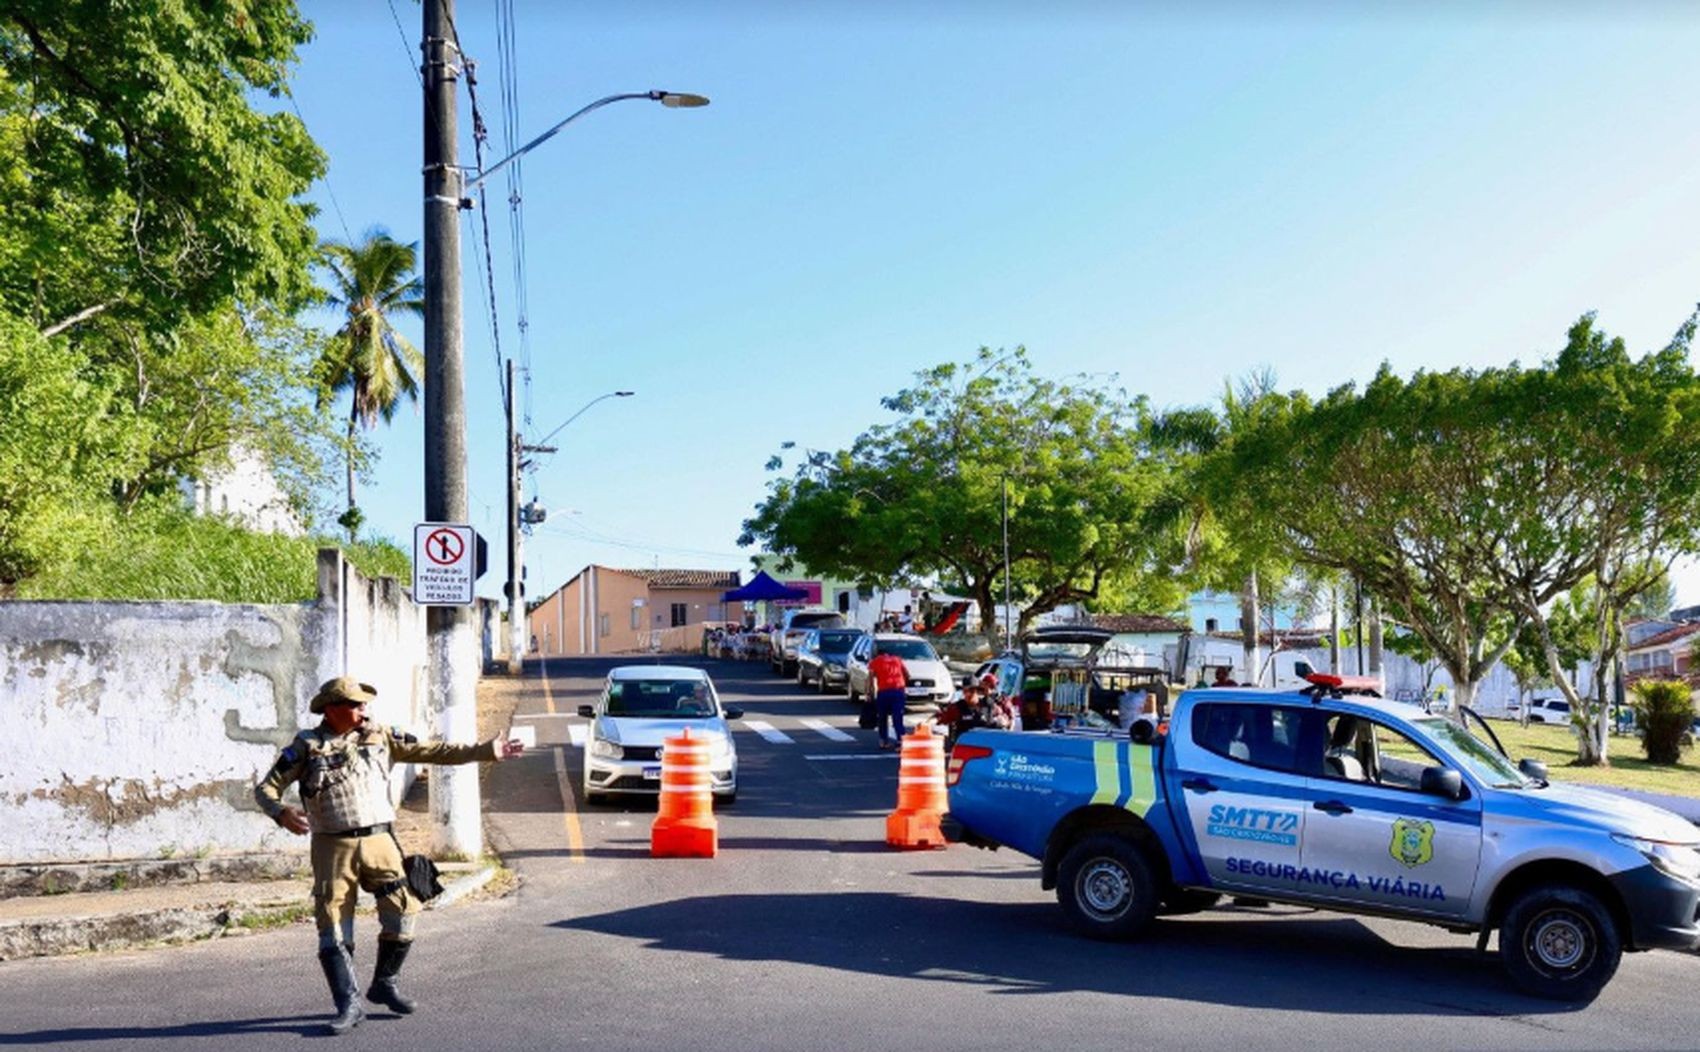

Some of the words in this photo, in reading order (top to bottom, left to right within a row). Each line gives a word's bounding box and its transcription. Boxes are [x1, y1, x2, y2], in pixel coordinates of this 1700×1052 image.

[1208, 804, 1282, 830] SMTT
[1226, 857, 1360, 890] SEGURANÇA
[1368, 875, 1446, 902] VIÁRIA
